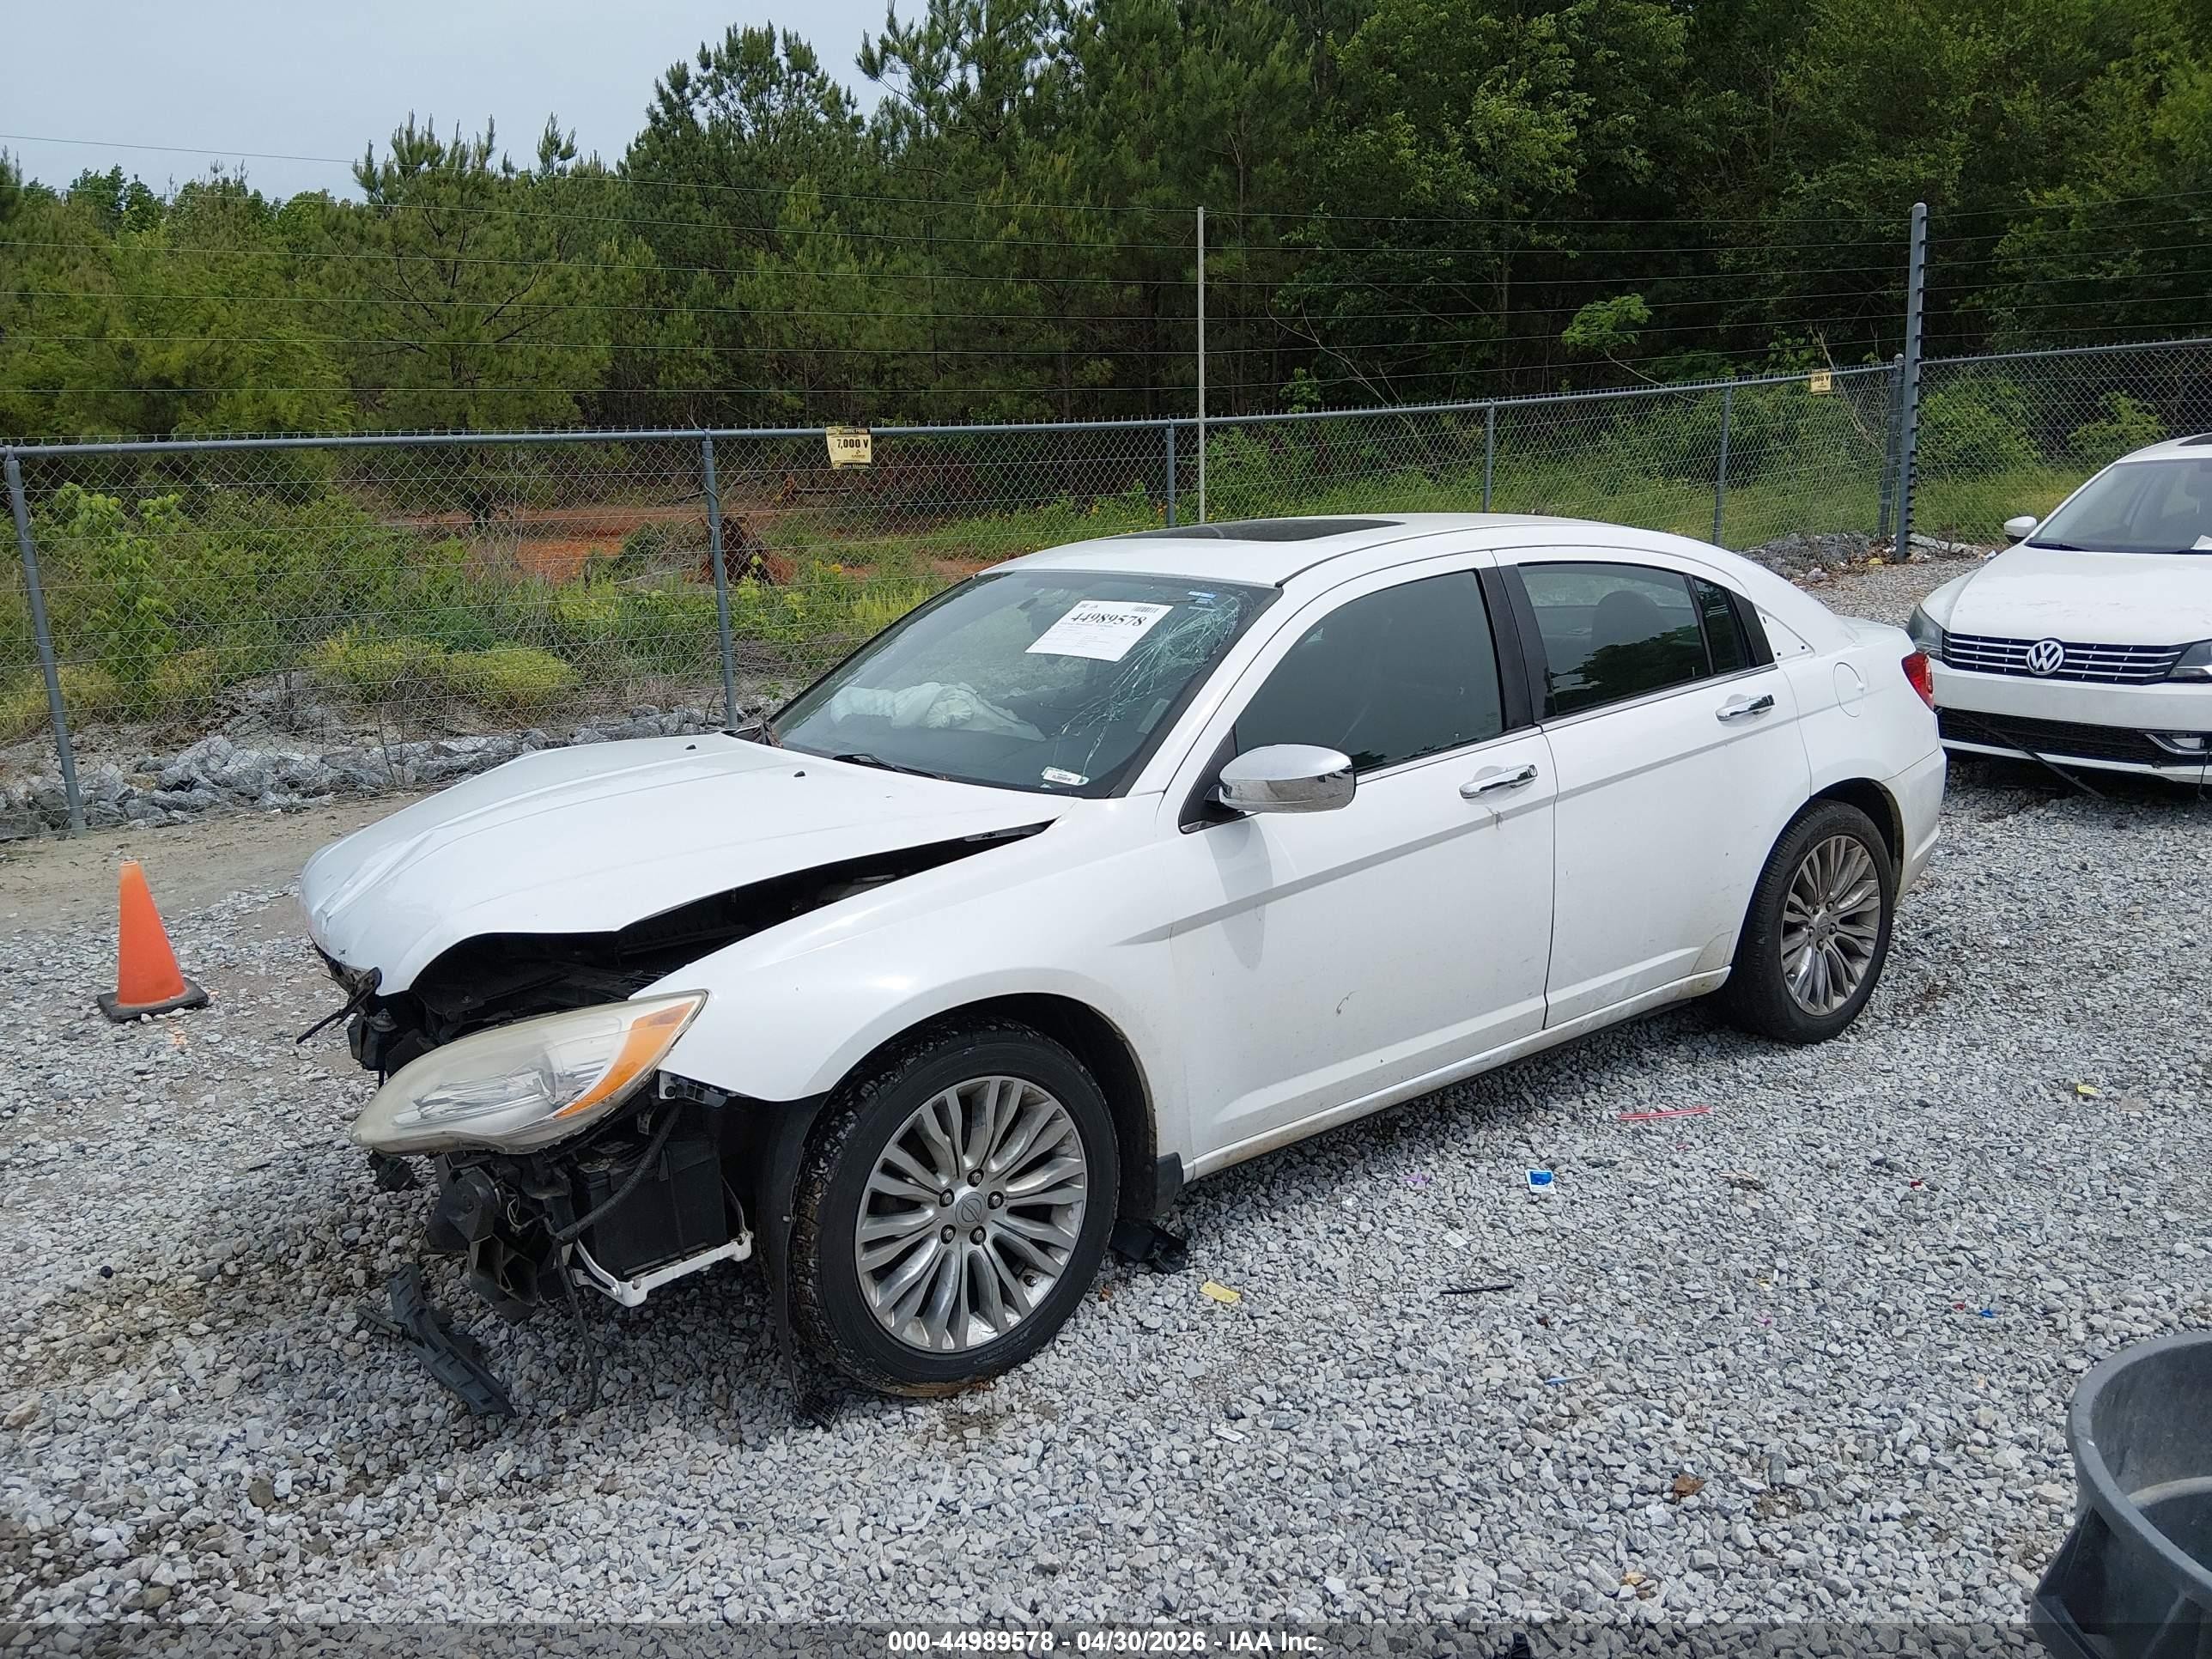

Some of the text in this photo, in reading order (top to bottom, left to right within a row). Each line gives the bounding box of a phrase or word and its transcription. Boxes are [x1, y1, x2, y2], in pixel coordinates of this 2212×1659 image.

[836, 438, 869, 450] 7,000 V
[1071, 611, 1147, 627] 44989578
